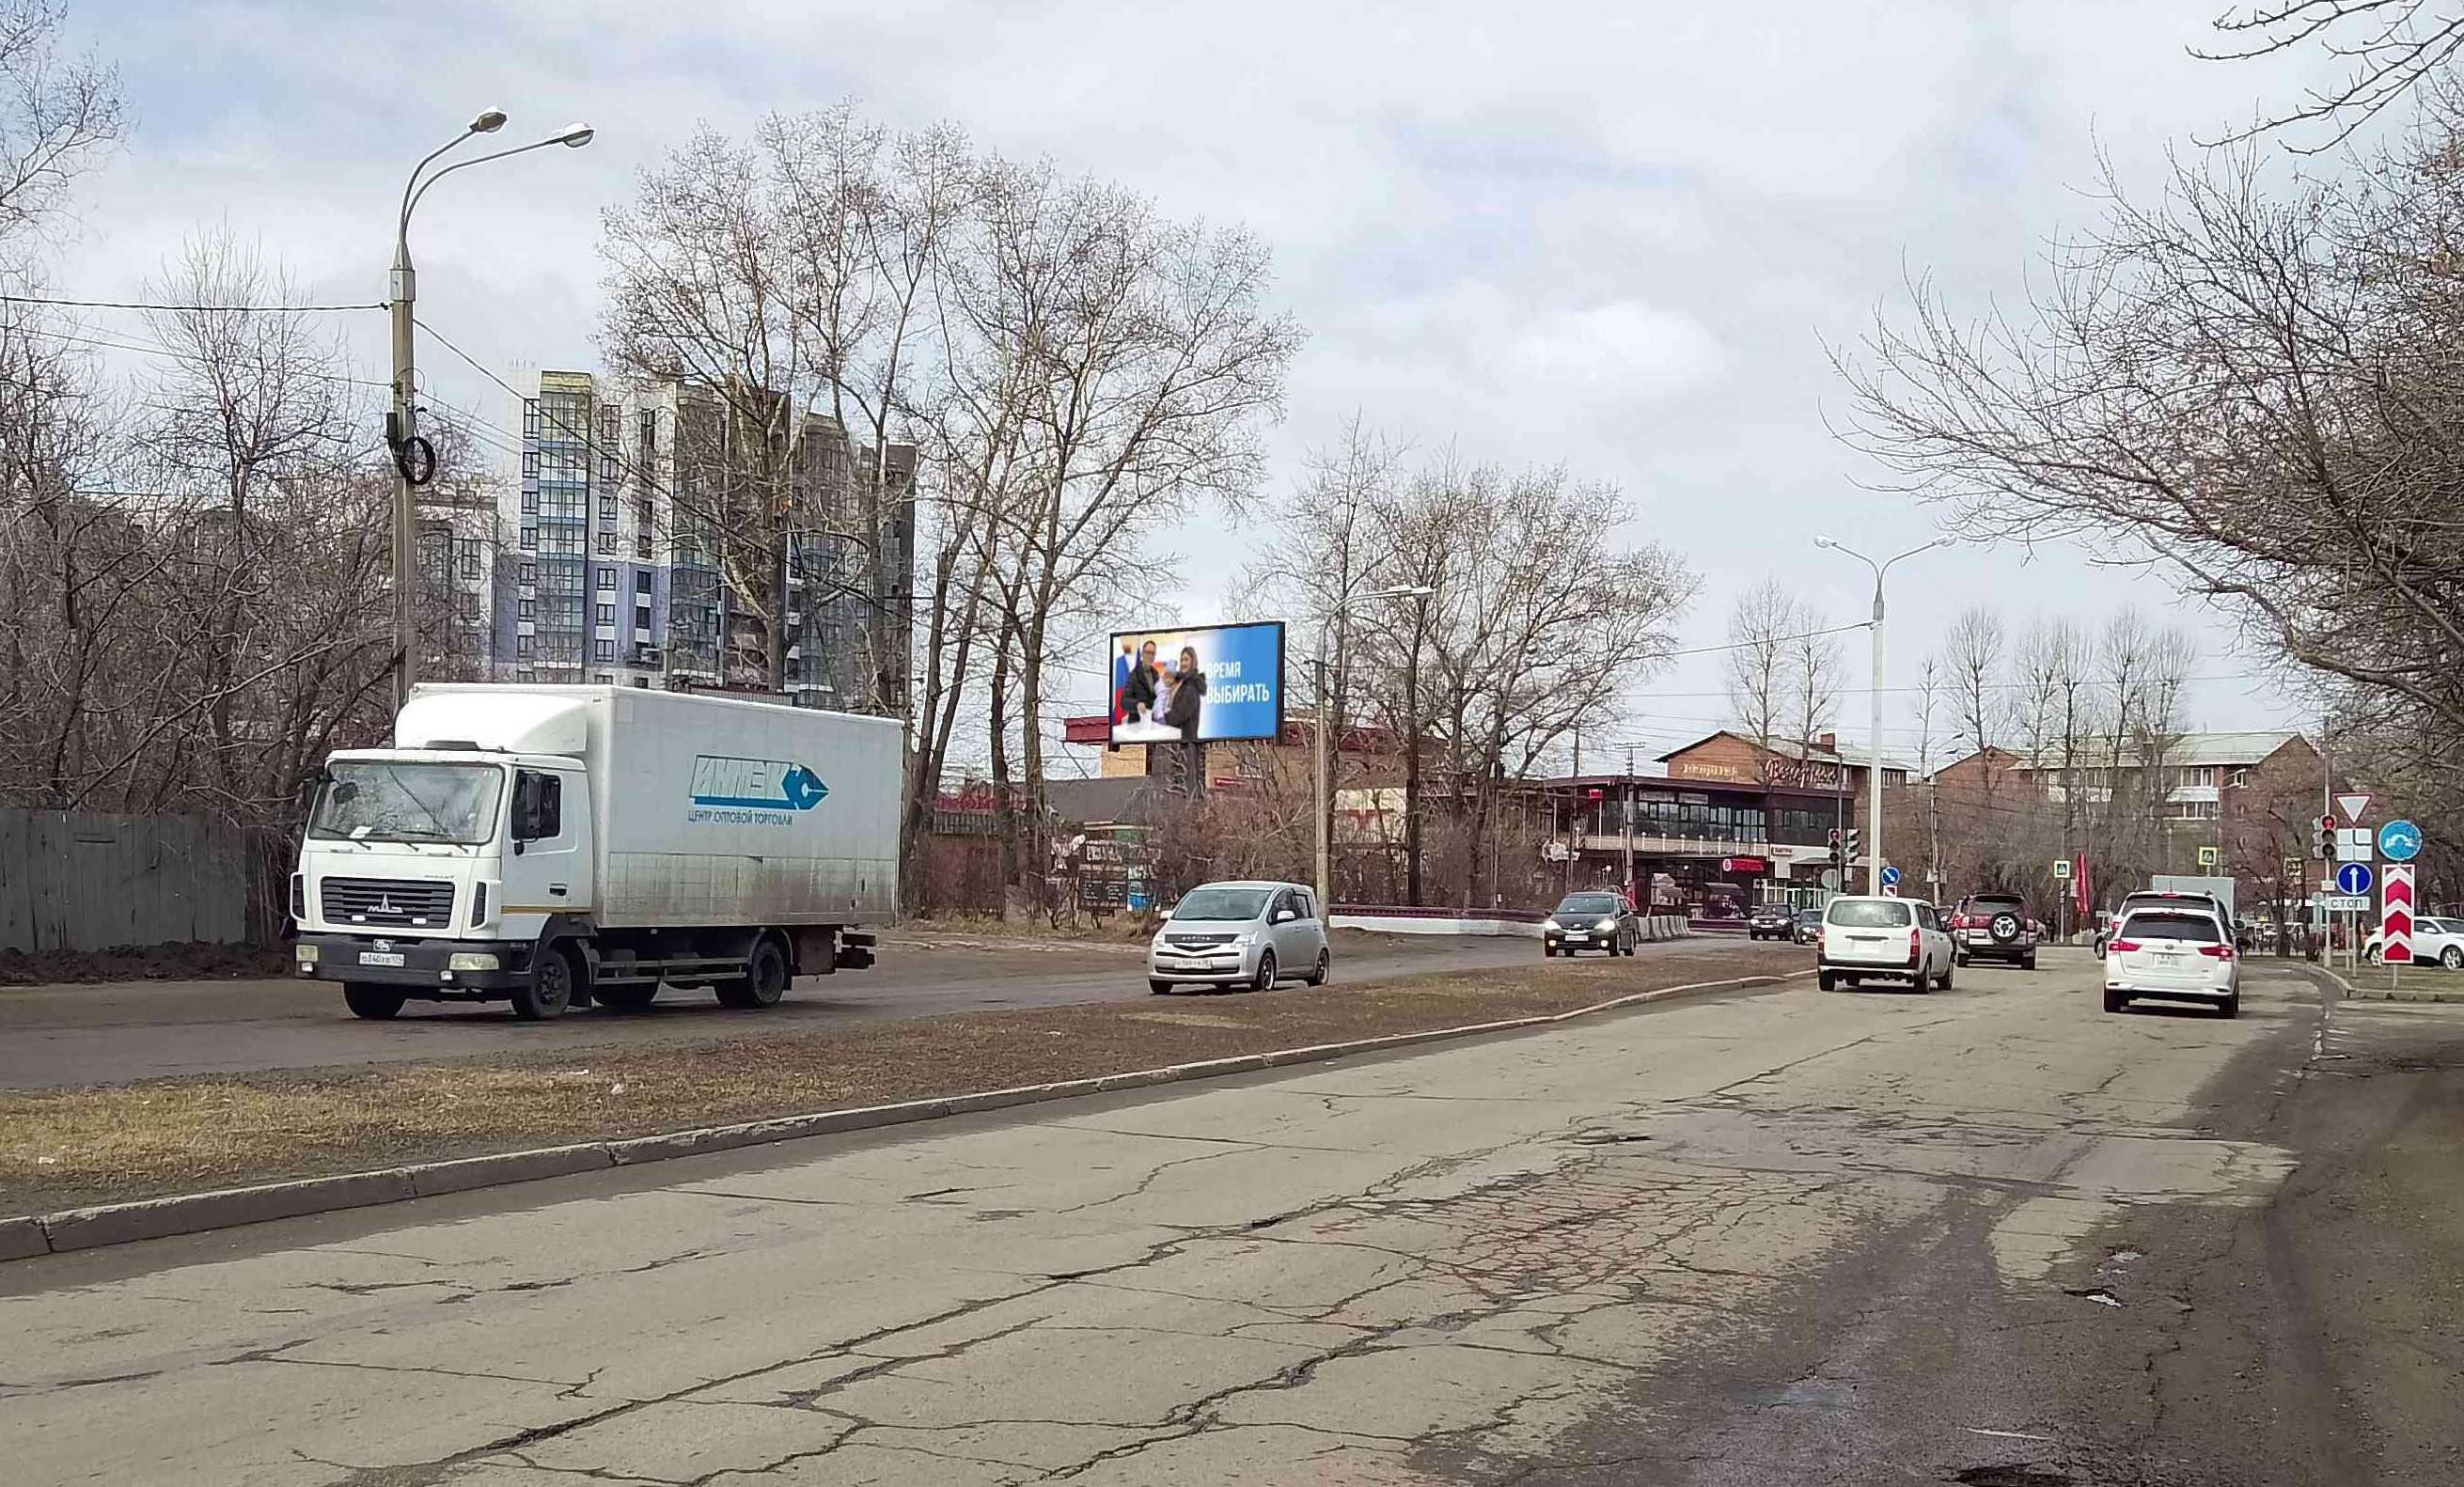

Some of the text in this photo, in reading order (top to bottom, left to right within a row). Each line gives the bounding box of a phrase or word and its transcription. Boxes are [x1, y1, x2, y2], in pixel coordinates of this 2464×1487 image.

[1205, 661, 1242, 679] ВРЕМЯ
[1206, 682, 1270, 704] ВЫБИРАТЬ
[687, 809, 793, 826] ЦЕНТР ОПТОВОЙ ТОРГОВЛИ
[2331, 899, 2362, 909] СТОП
